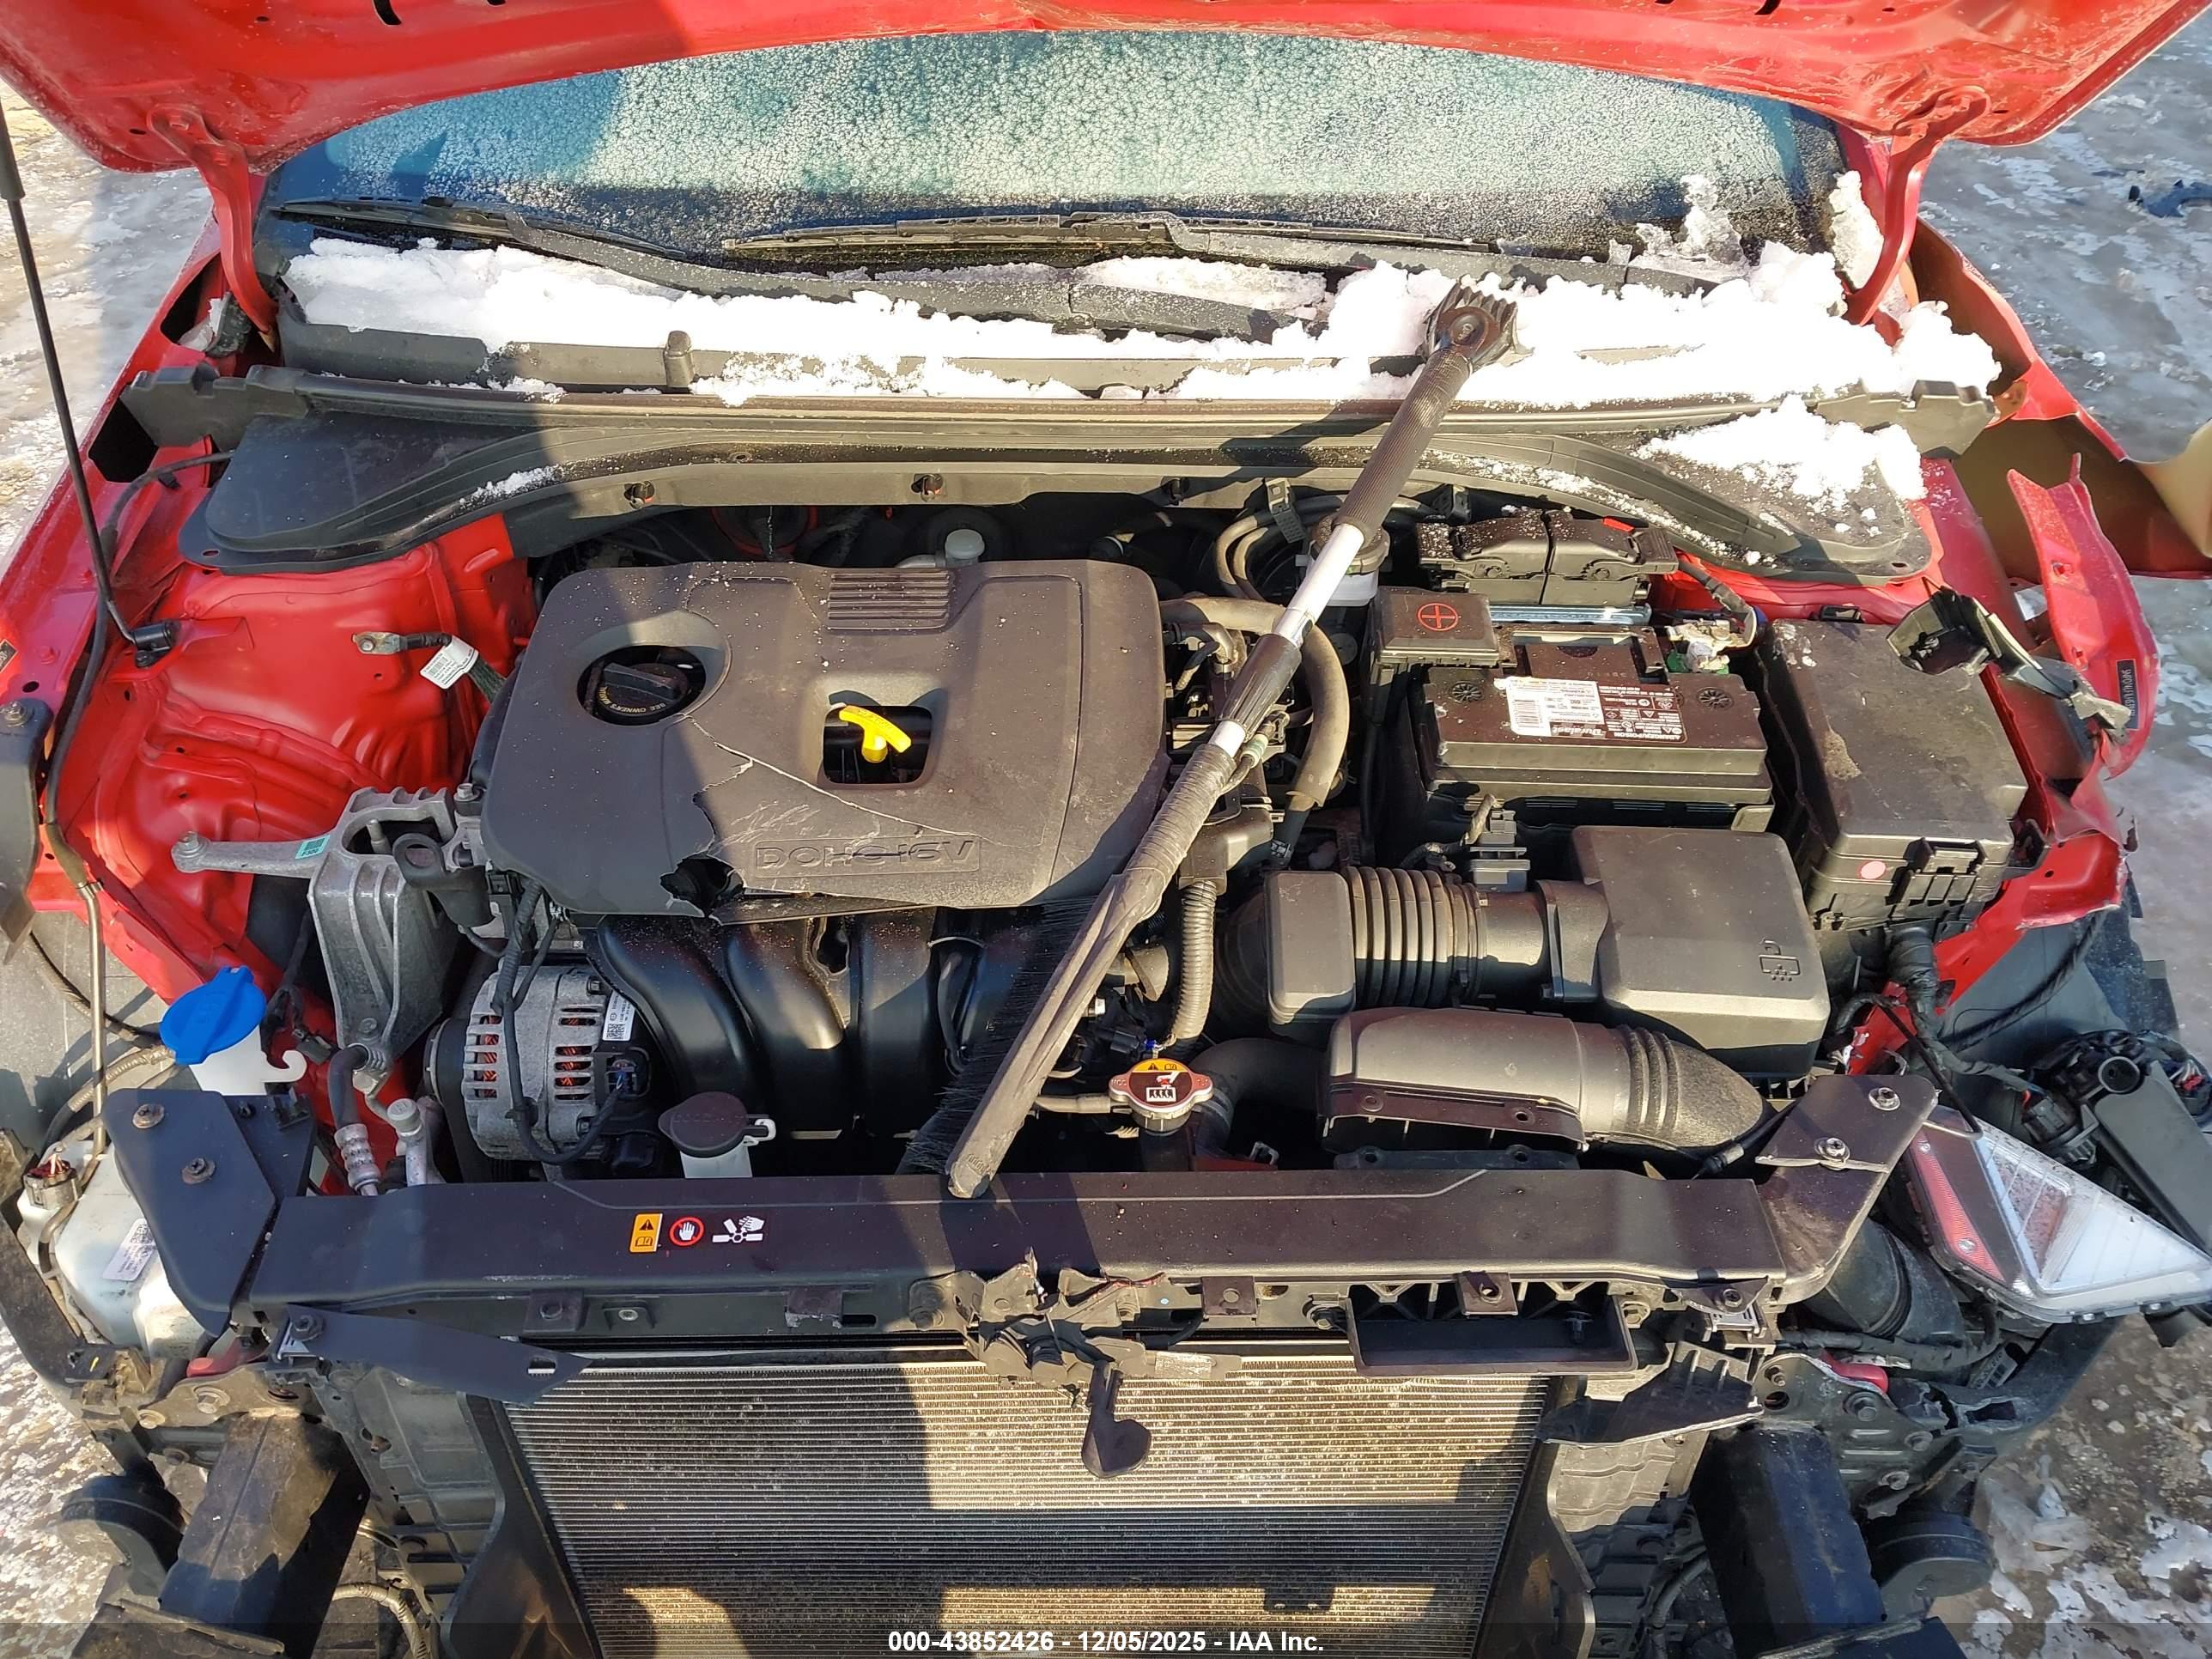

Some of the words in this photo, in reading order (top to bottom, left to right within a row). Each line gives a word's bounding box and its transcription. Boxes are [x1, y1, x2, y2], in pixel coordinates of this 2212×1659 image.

[610, 703, 647, 713] OWNER'S
[649, 702, 666, 711] SEE
[1552, 726, 1606, 736] Duralast
